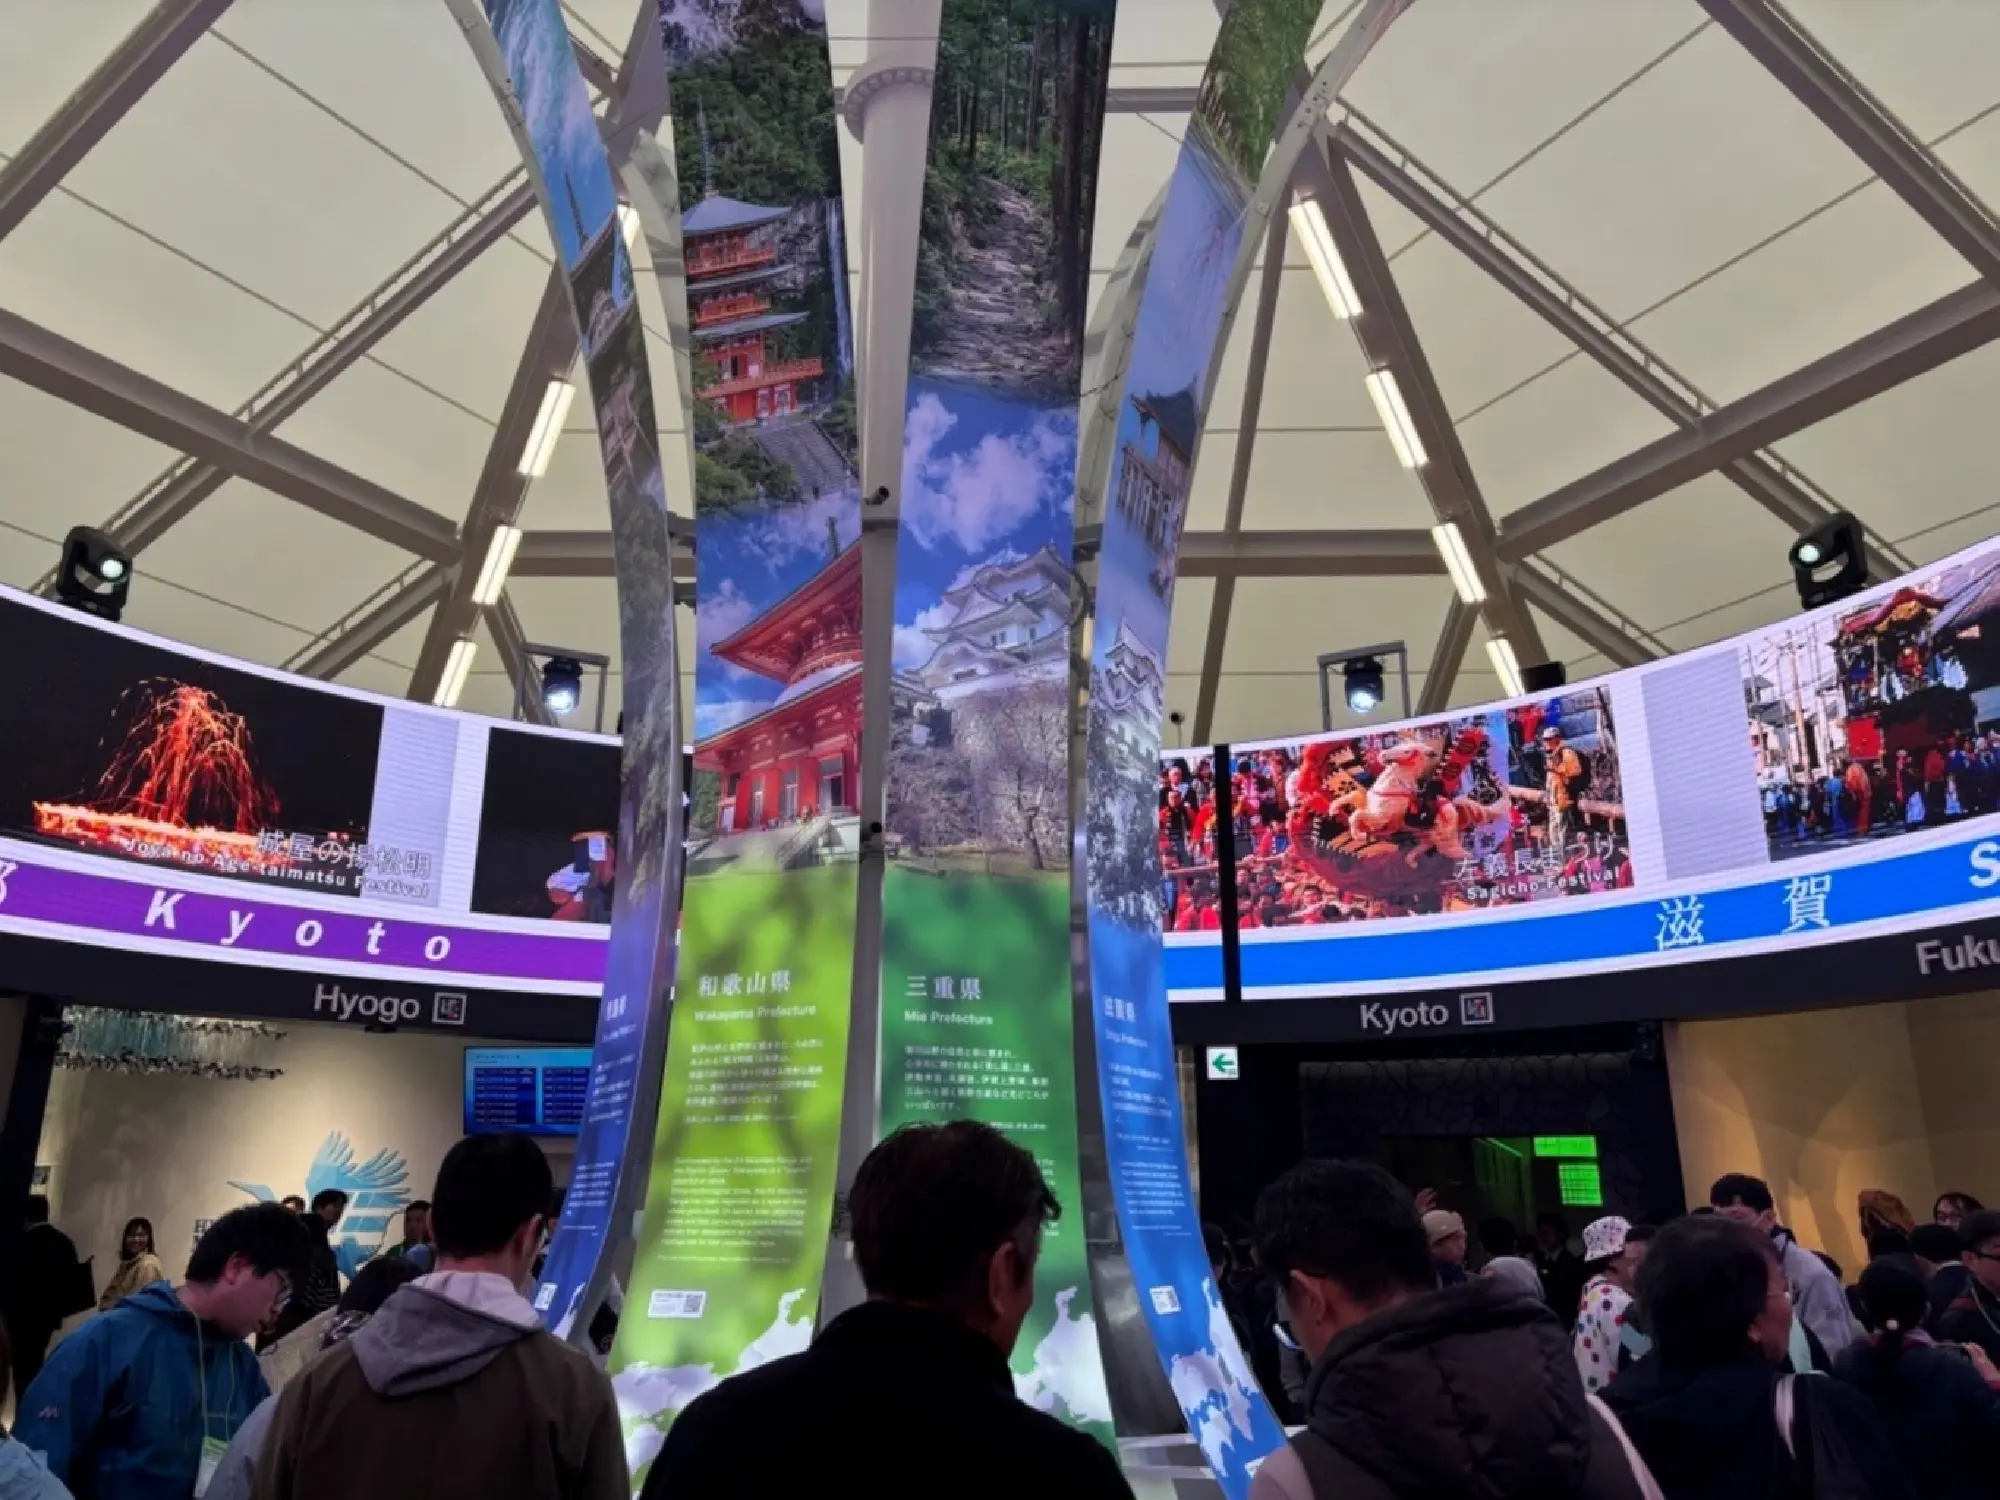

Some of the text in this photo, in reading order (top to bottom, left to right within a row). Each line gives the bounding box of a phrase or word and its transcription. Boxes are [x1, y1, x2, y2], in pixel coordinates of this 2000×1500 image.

[354, 876, 431, 899] Festival
[1467, 866, 1620, 900] Sagicho Festival
[144, 888, 451, 962] Kyoto
[313, 983, 421, 1023] Hyogo
[905, 975, 981, 1000] 三重県
[904, 1010, 994, 1026] Mie Prefecture
[1360, 999, 1449, 1035] Kyoto
